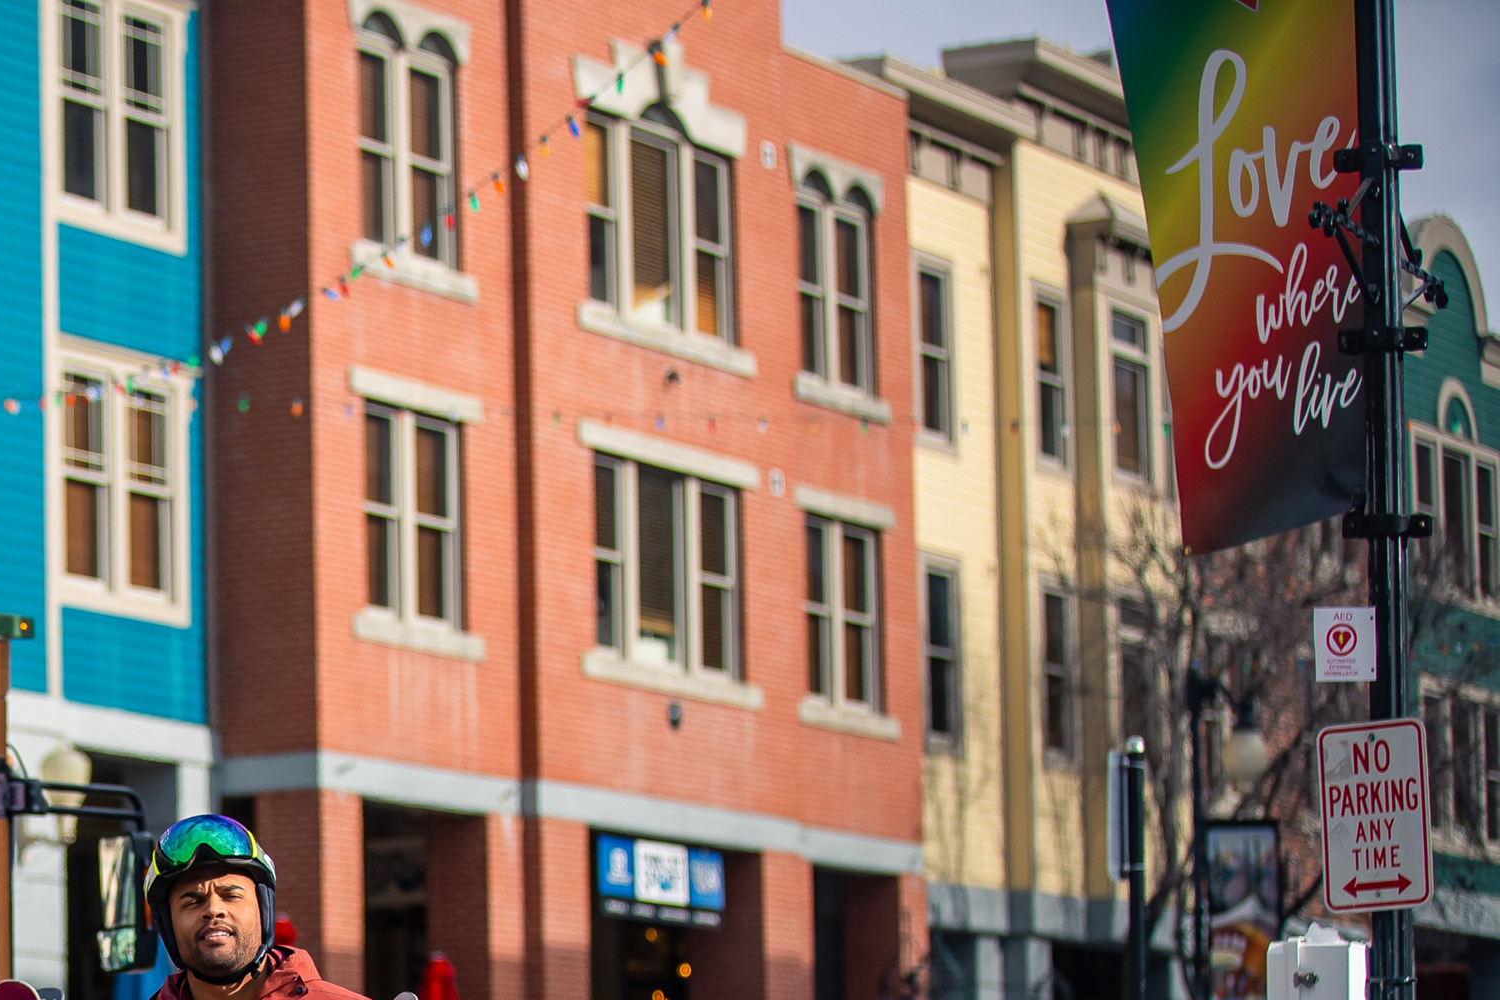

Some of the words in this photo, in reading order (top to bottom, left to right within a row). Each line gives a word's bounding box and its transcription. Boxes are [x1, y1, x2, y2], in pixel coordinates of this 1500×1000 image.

[1157, 49, 1357, 332] Love
[1256, 242, 1361, 344] where
[1205, 354, 1292, 469] you
[1294, 341, 1363, 435] live
[1333, 611, 1353, 621] AED
[1352, 739, 1391, 775] NO
[1329, 778, 1418, 818] PARKING
[1355, 818, 1394, 843] ANY
[1352, 845, 1402, 871] TIME
